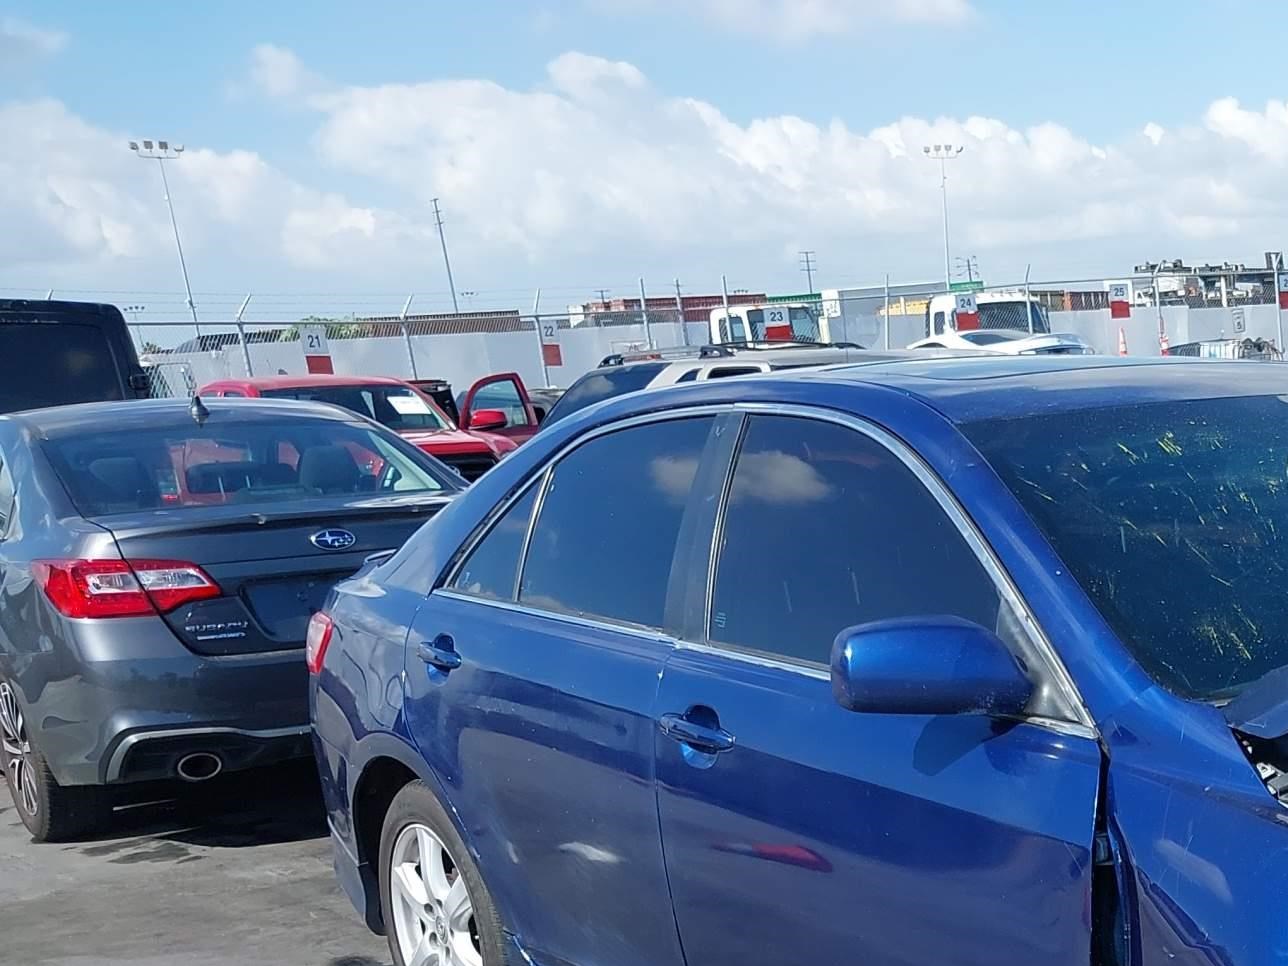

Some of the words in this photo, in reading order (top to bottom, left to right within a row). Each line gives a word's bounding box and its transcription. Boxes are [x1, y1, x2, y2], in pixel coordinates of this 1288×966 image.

[1113, 287, 1125, 297] 25
[959, 298, 972, 309] 24
[769, 311, 784, 322] 23
[543, 325, 555, 337] 22
[307, 334, 321, 348] 21
